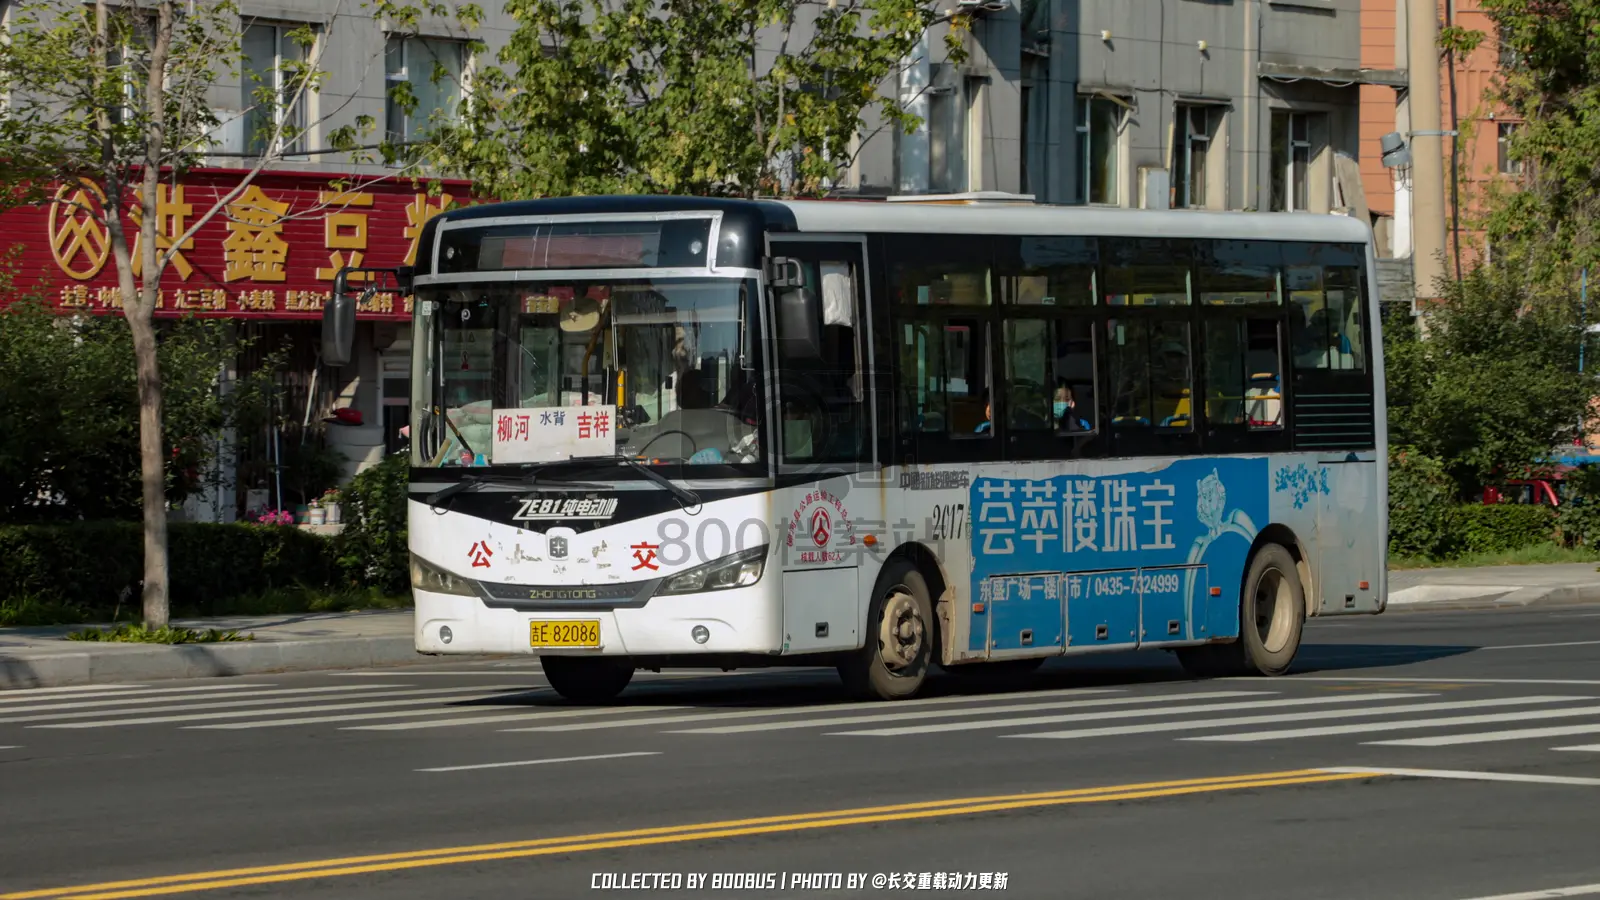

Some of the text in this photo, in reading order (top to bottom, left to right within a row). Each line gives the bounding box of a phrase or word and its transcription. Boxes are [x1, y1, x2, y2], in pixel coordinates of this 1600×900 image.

[497, 411, 610, 441] 柳河 水背 吉祥
[932, 503, 964, 540] 2017
[978, 479, 1176, 555] 荟萃楼珠宝
[468, 540, 660, 571] 公 交
[529, 589, 596, 599] ZHONGTONG
[1094, 573, 1179, 596] 0435-7324999
